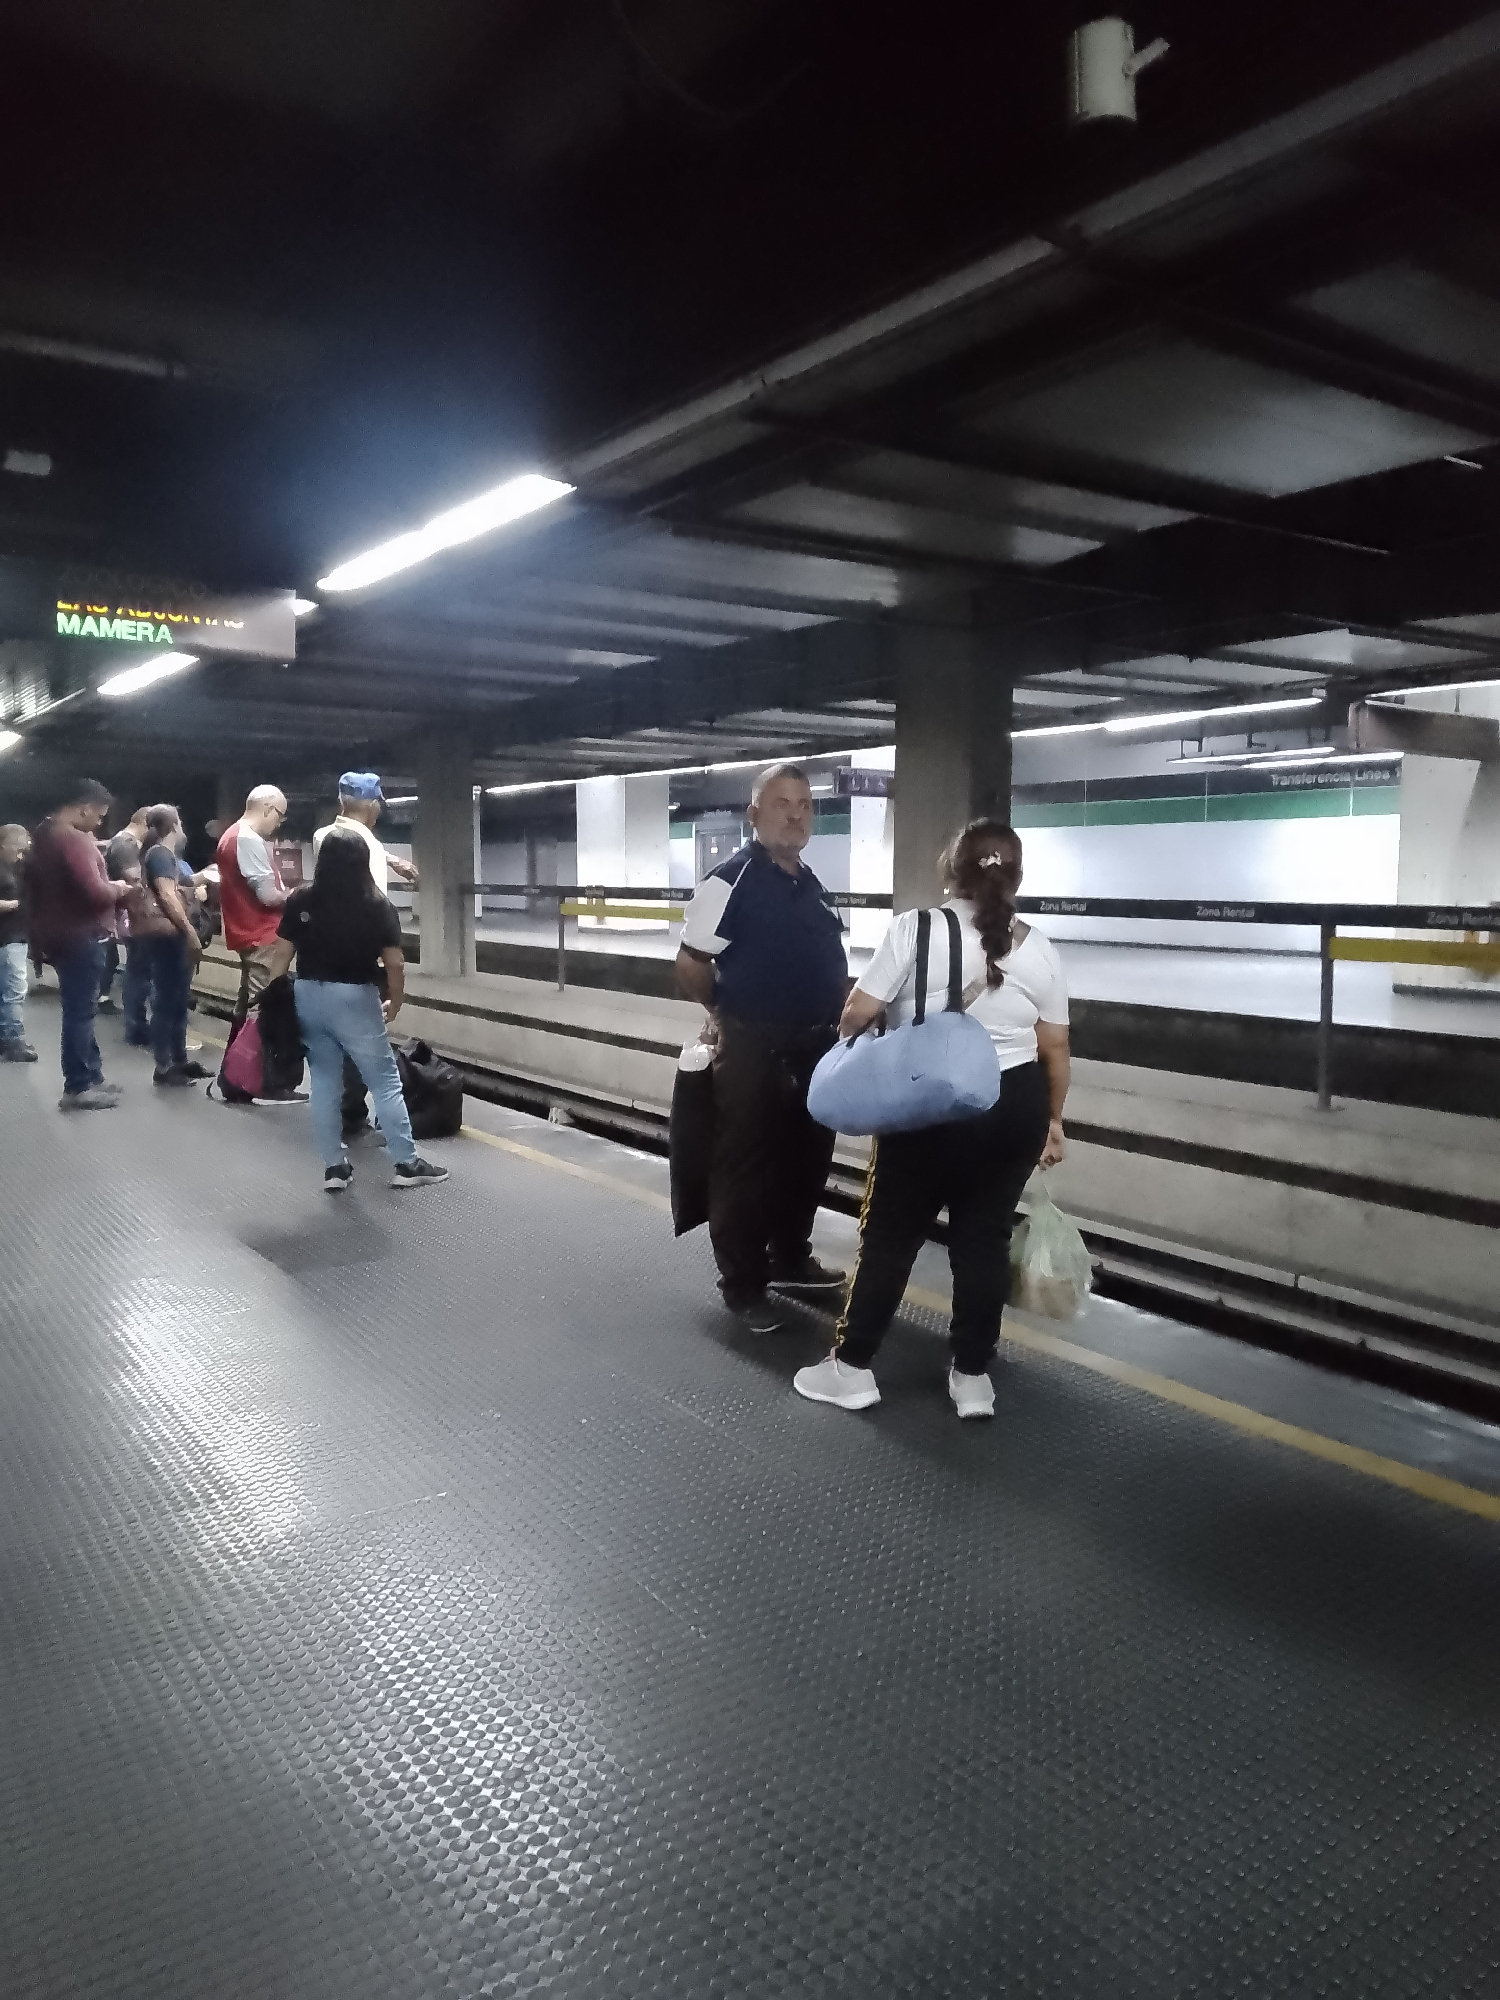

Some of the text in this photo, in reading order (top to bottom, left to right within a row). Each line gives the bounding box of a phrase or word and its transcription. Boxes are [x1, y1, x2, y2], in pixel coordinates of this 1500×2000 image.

[57, 612, 174, 644] MAMERA
[1271, 771, 1351, 787] Transferencia
[1040, 900, 1087, 912] Zona Rental
[1196, 905, 1255, 918] Zona Rental
[1427, 911, 1459, 925] Zona
